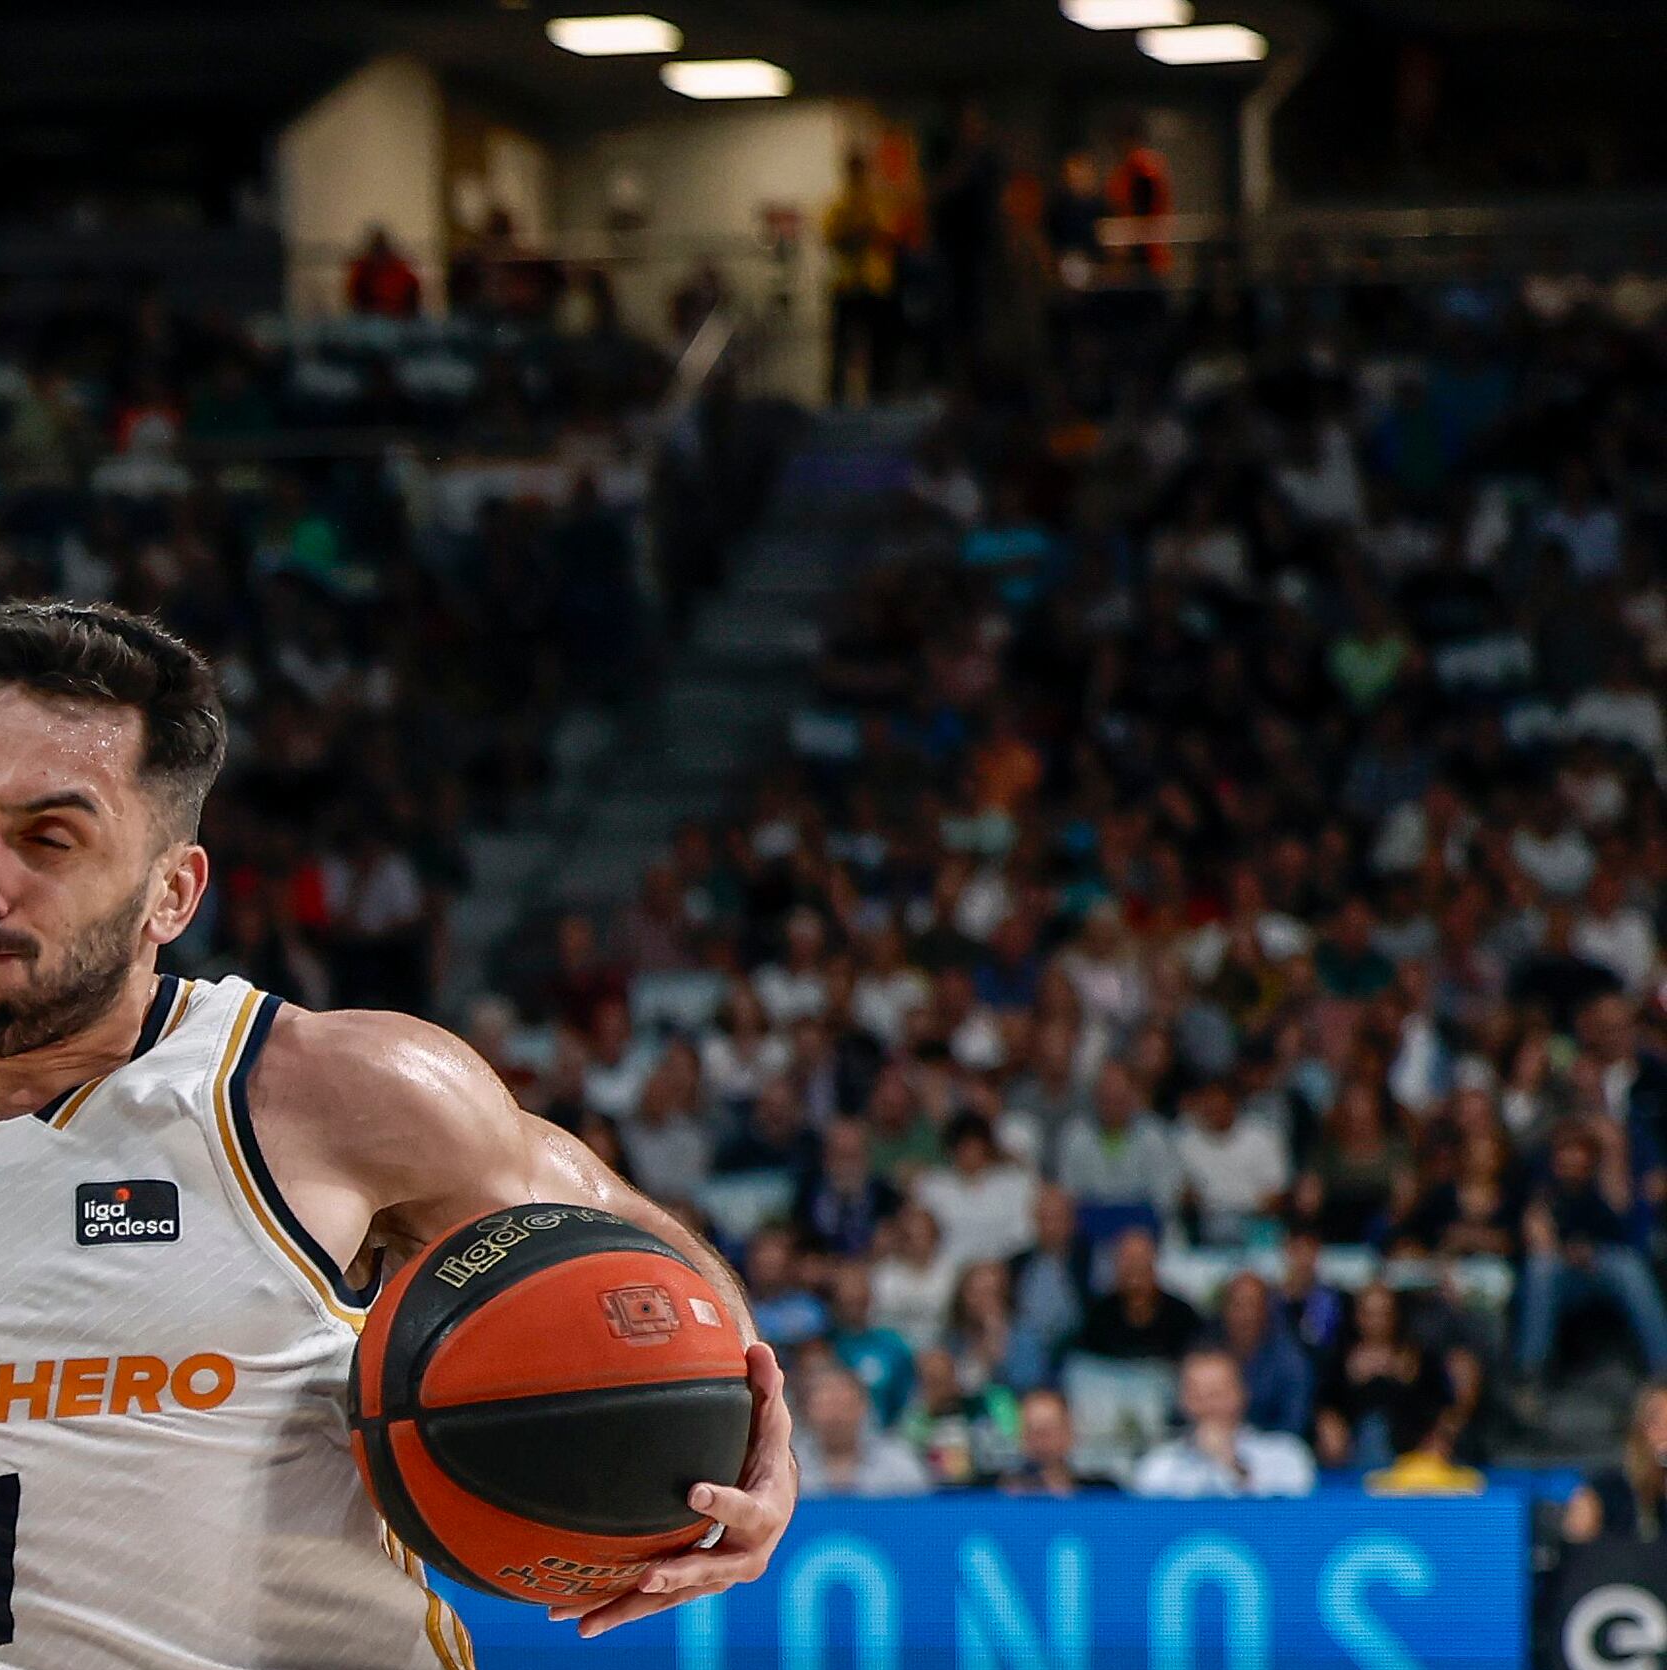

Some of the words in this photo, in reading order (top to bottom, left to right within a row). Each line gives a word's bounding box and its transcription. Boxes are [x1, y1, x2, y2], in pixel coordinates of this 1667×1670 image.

[84, 1200, 125, 1221] liga
[84, 1216, 174, 1237] endesa
[435, 1223, 531, 1289] liga
